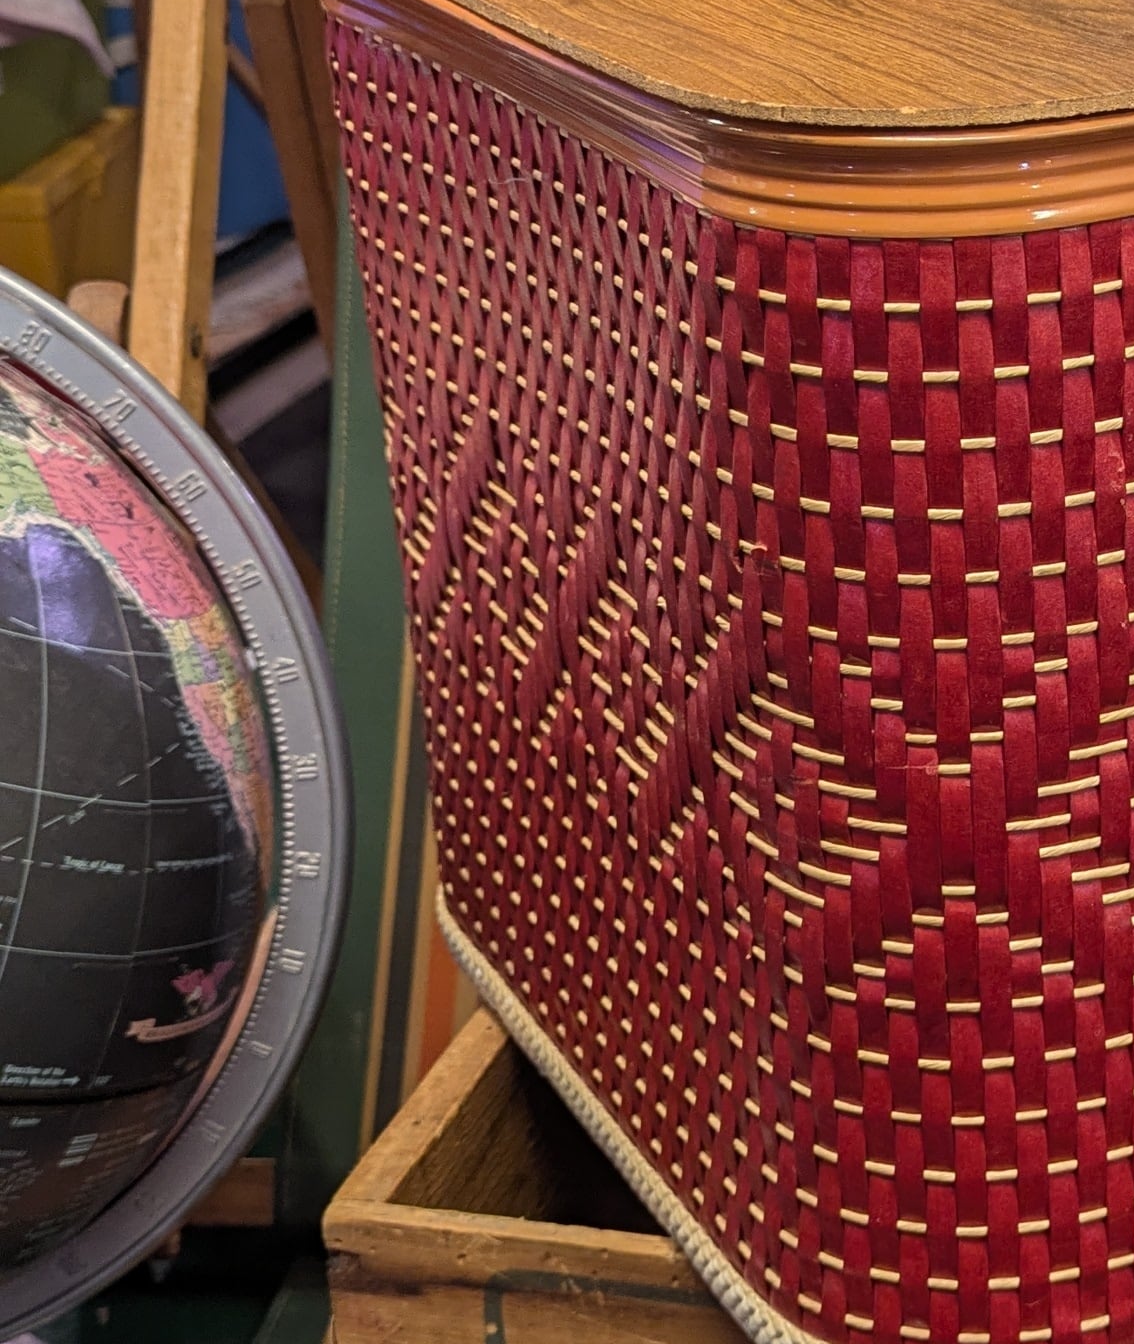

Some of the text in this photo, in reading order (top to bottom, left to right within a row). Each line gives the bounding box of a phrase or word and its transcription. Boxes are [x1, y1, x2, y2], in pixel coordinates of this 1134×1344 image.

[103, 389, 138, 423] 70
[175, 470, 208, 503] 60
[232, 559, 262, 591] 50
